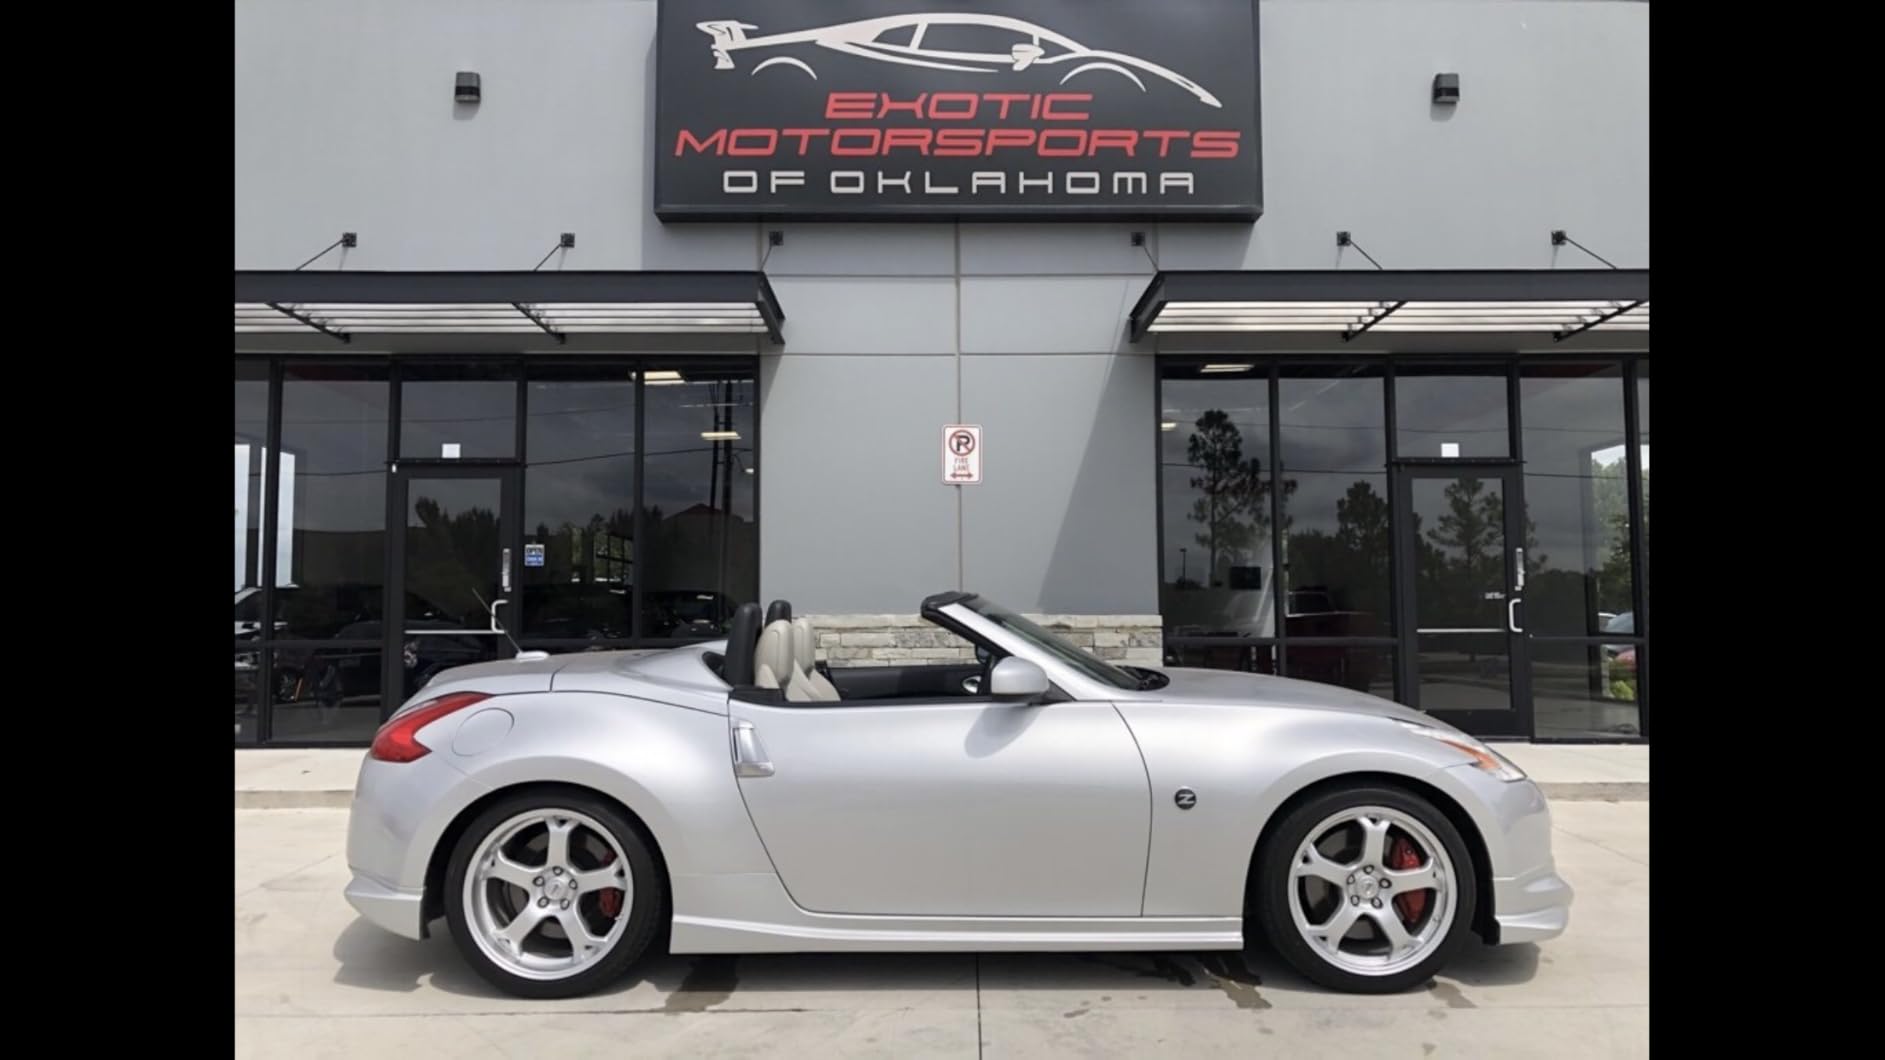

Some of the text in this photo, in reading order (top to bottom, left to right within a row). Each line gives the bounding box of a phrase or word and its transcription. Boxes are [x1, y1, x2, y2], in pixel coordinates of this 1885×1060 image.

[825, 92, 1093, 120] EXOTIC
[675, 128, 1241, 158] MOTORSPORTS
[723, 170, 1194, 194] OF OKLAHOMA
[1177, 793, 1195, 805] Z
